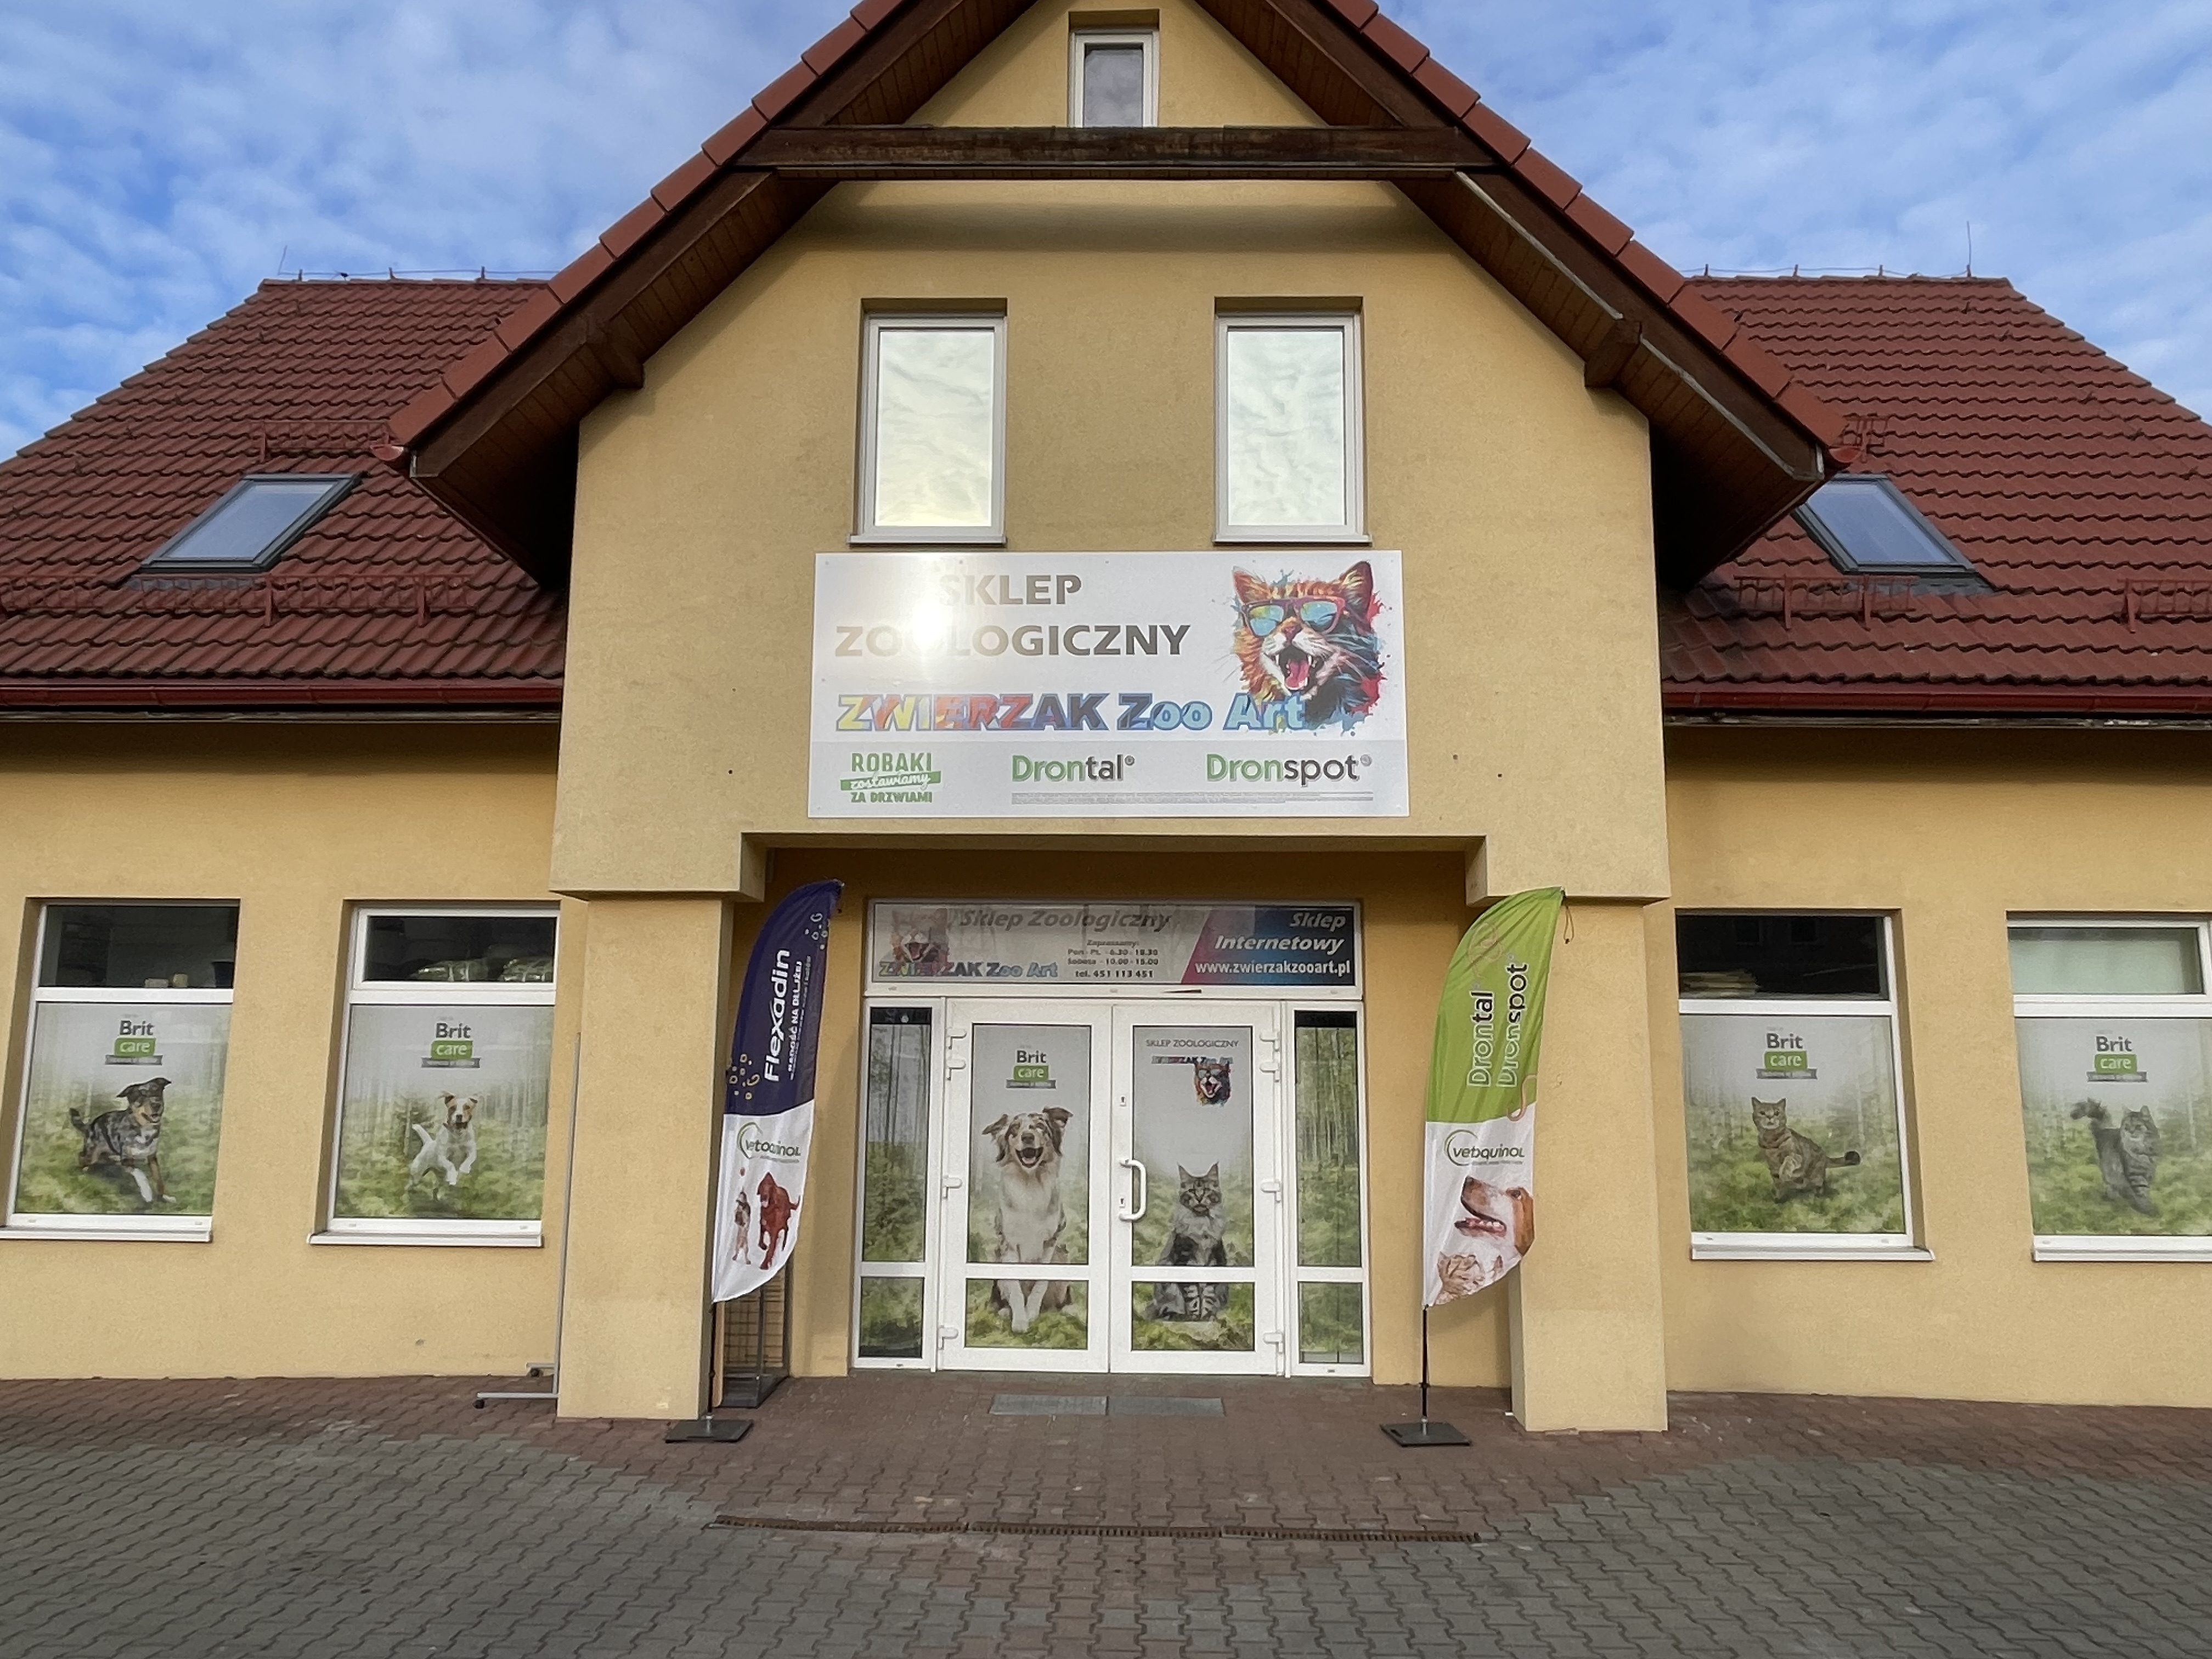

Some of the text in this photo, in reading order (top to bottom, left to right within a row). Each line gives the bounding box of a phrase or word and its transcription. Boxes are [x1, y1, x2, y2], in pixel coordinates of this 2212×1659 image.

[939, 574, 1082, 605] SKLEP
[835, 624, 1190, 656] ZOLOGICZNY
[836, 692, 1305, 731] ZWIERZAK Zoo Art
[851, 752, 932, 772] ROBAKI
[850, 770, 932, 791] zostawiamy
[851, 792, 933, 803] ZA DRZWIAMI
[961, 910, 1172, 932] Sklep Zoologiczny
[1289, 912, 1346, 932] Sklep
[1215, 935, 1345, 955] Internetowy
[1026, 962, 1058, 978] Art
[1195, 960, 1351, 977] www.zwierzakzooart.pl
[764, 949, 791, 1082] Flexadin
[119, 1020, 155, 1036] Brit
[436, 1022, 472, 1039] Brit
[1496, 963, 1529, 1087] Dronspot
[119, 1041, 151, 1053] care
[1173, 1039, 1239, 1048] ZOOLOGICZNY
[1467, 991, 1493, 1087] Drontal
[1766, 1032, 1804, 1049] Brit
[2096, 1035, 2132, 1052] Brit
[436, 1044, 468, 1056] care
[1016, 1050, 1047, 1063] Brit
[1770, 1054, 1802, 1067] care
[2100, 1057, 2132, 1070] care
[1018, 1068, 1045, 1078] care
